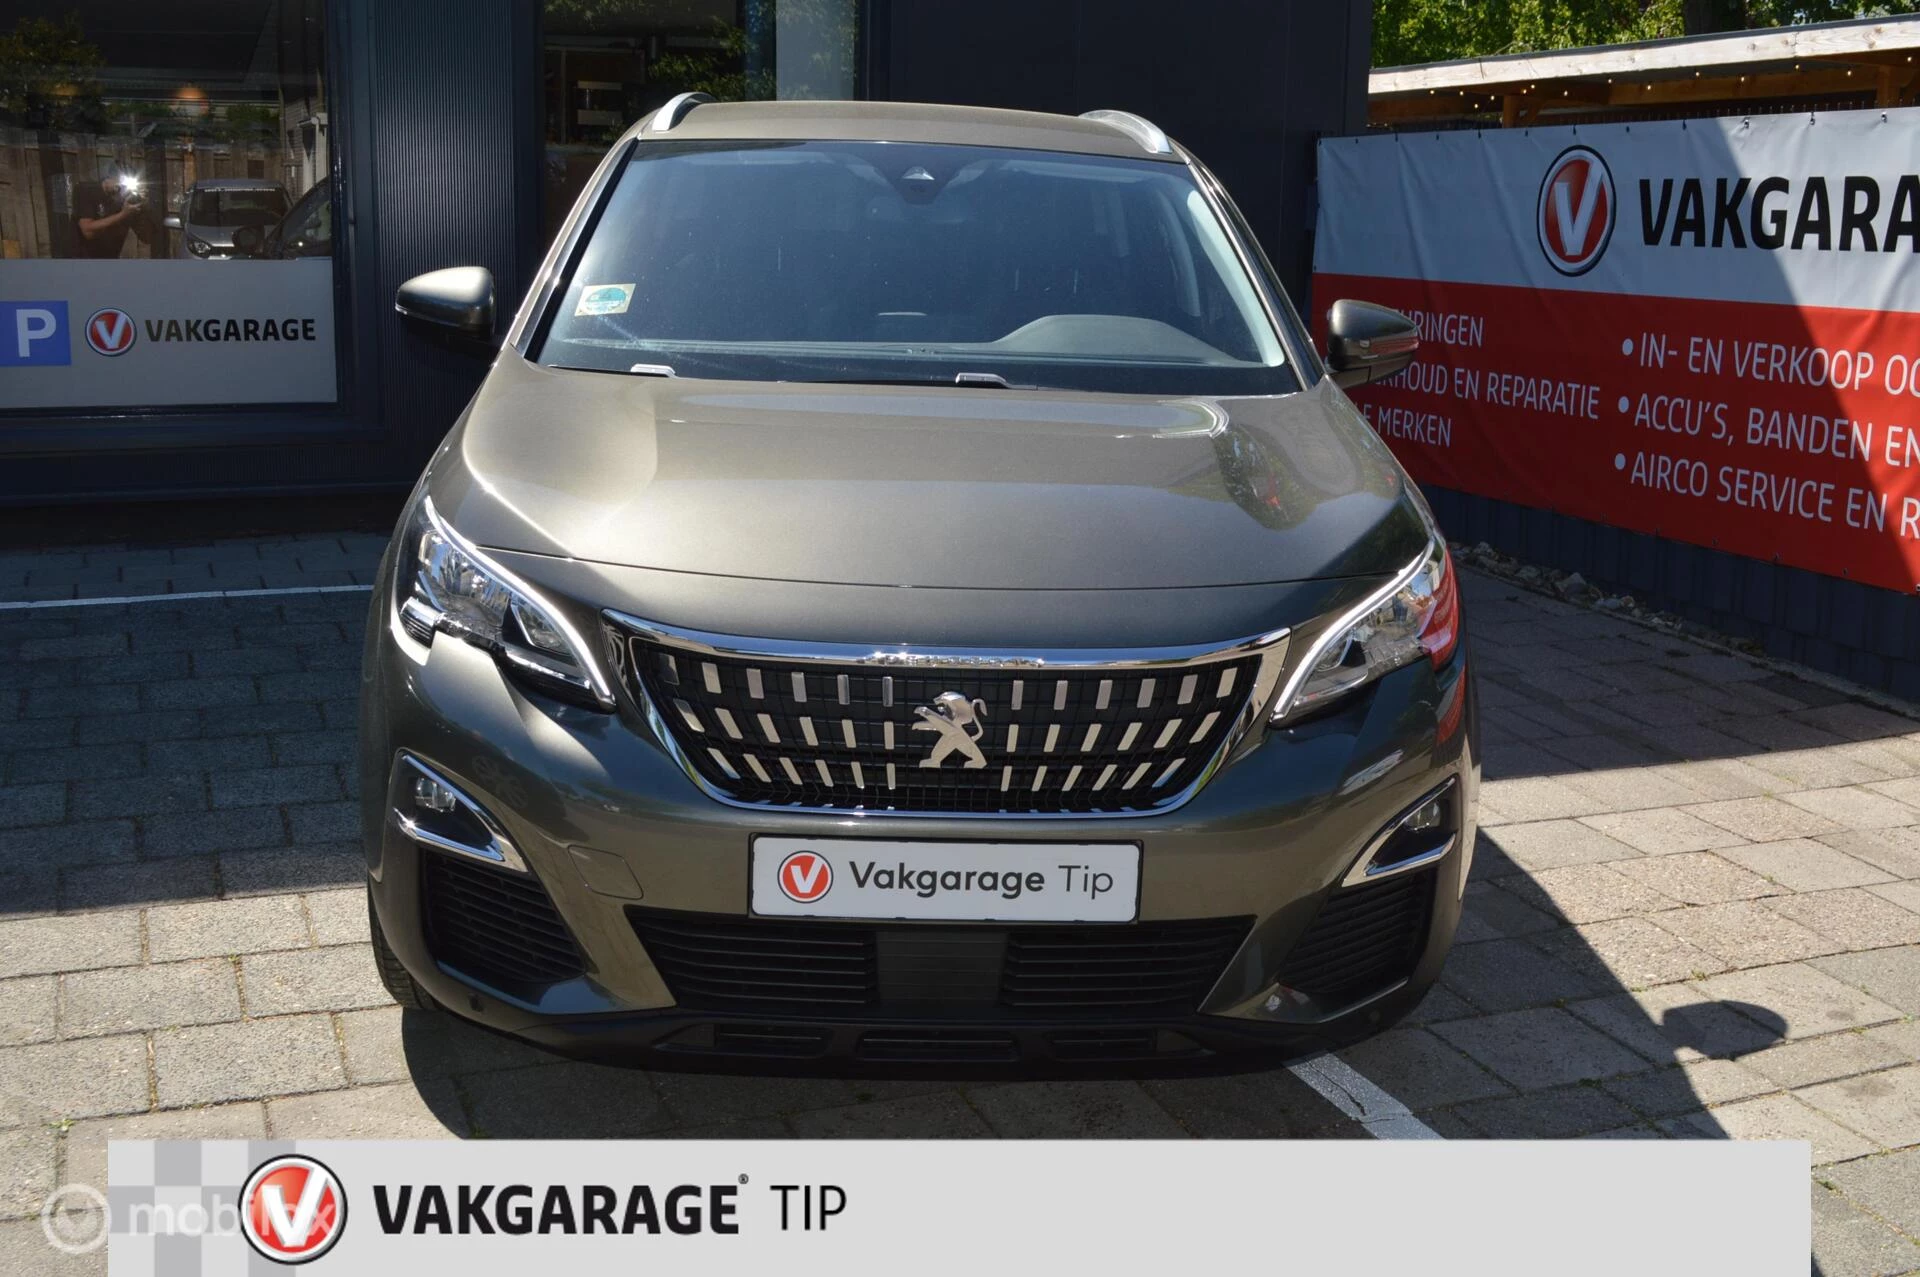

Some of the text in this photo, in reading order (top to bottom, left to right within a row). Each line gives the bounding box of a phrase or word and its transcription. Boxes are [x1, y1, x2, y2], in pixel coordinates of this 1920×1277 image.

[1639, 175, 1920, 253] VAKGARA
[16, 309, 57, 358] P
[145, 318, 316, 342] VAKGARAGE
[1640, 332, 1678, 368] IN-
[1688, 336, 1723, 375] EN
[1734, 340, 1874, 391] VERKOOP
[1454, 367, 1479, 400] EN
[1486, 372, 1601, 420] REPARATIE
[1377, 406, 1452, 447] MERKEN
[1634, 393, 1734, 446] ACCU'S,
[1746, 407, 1872, 462] BANDEN
[1630, 451, 1709, 497] AIRCO
[1716, 466, 1835, 522] SERVICE
[1845, 488, 1887, 532] EN
[848, 861, 1045, 899] Vakgarage
[1058, 865, 1114, 900] Tip
